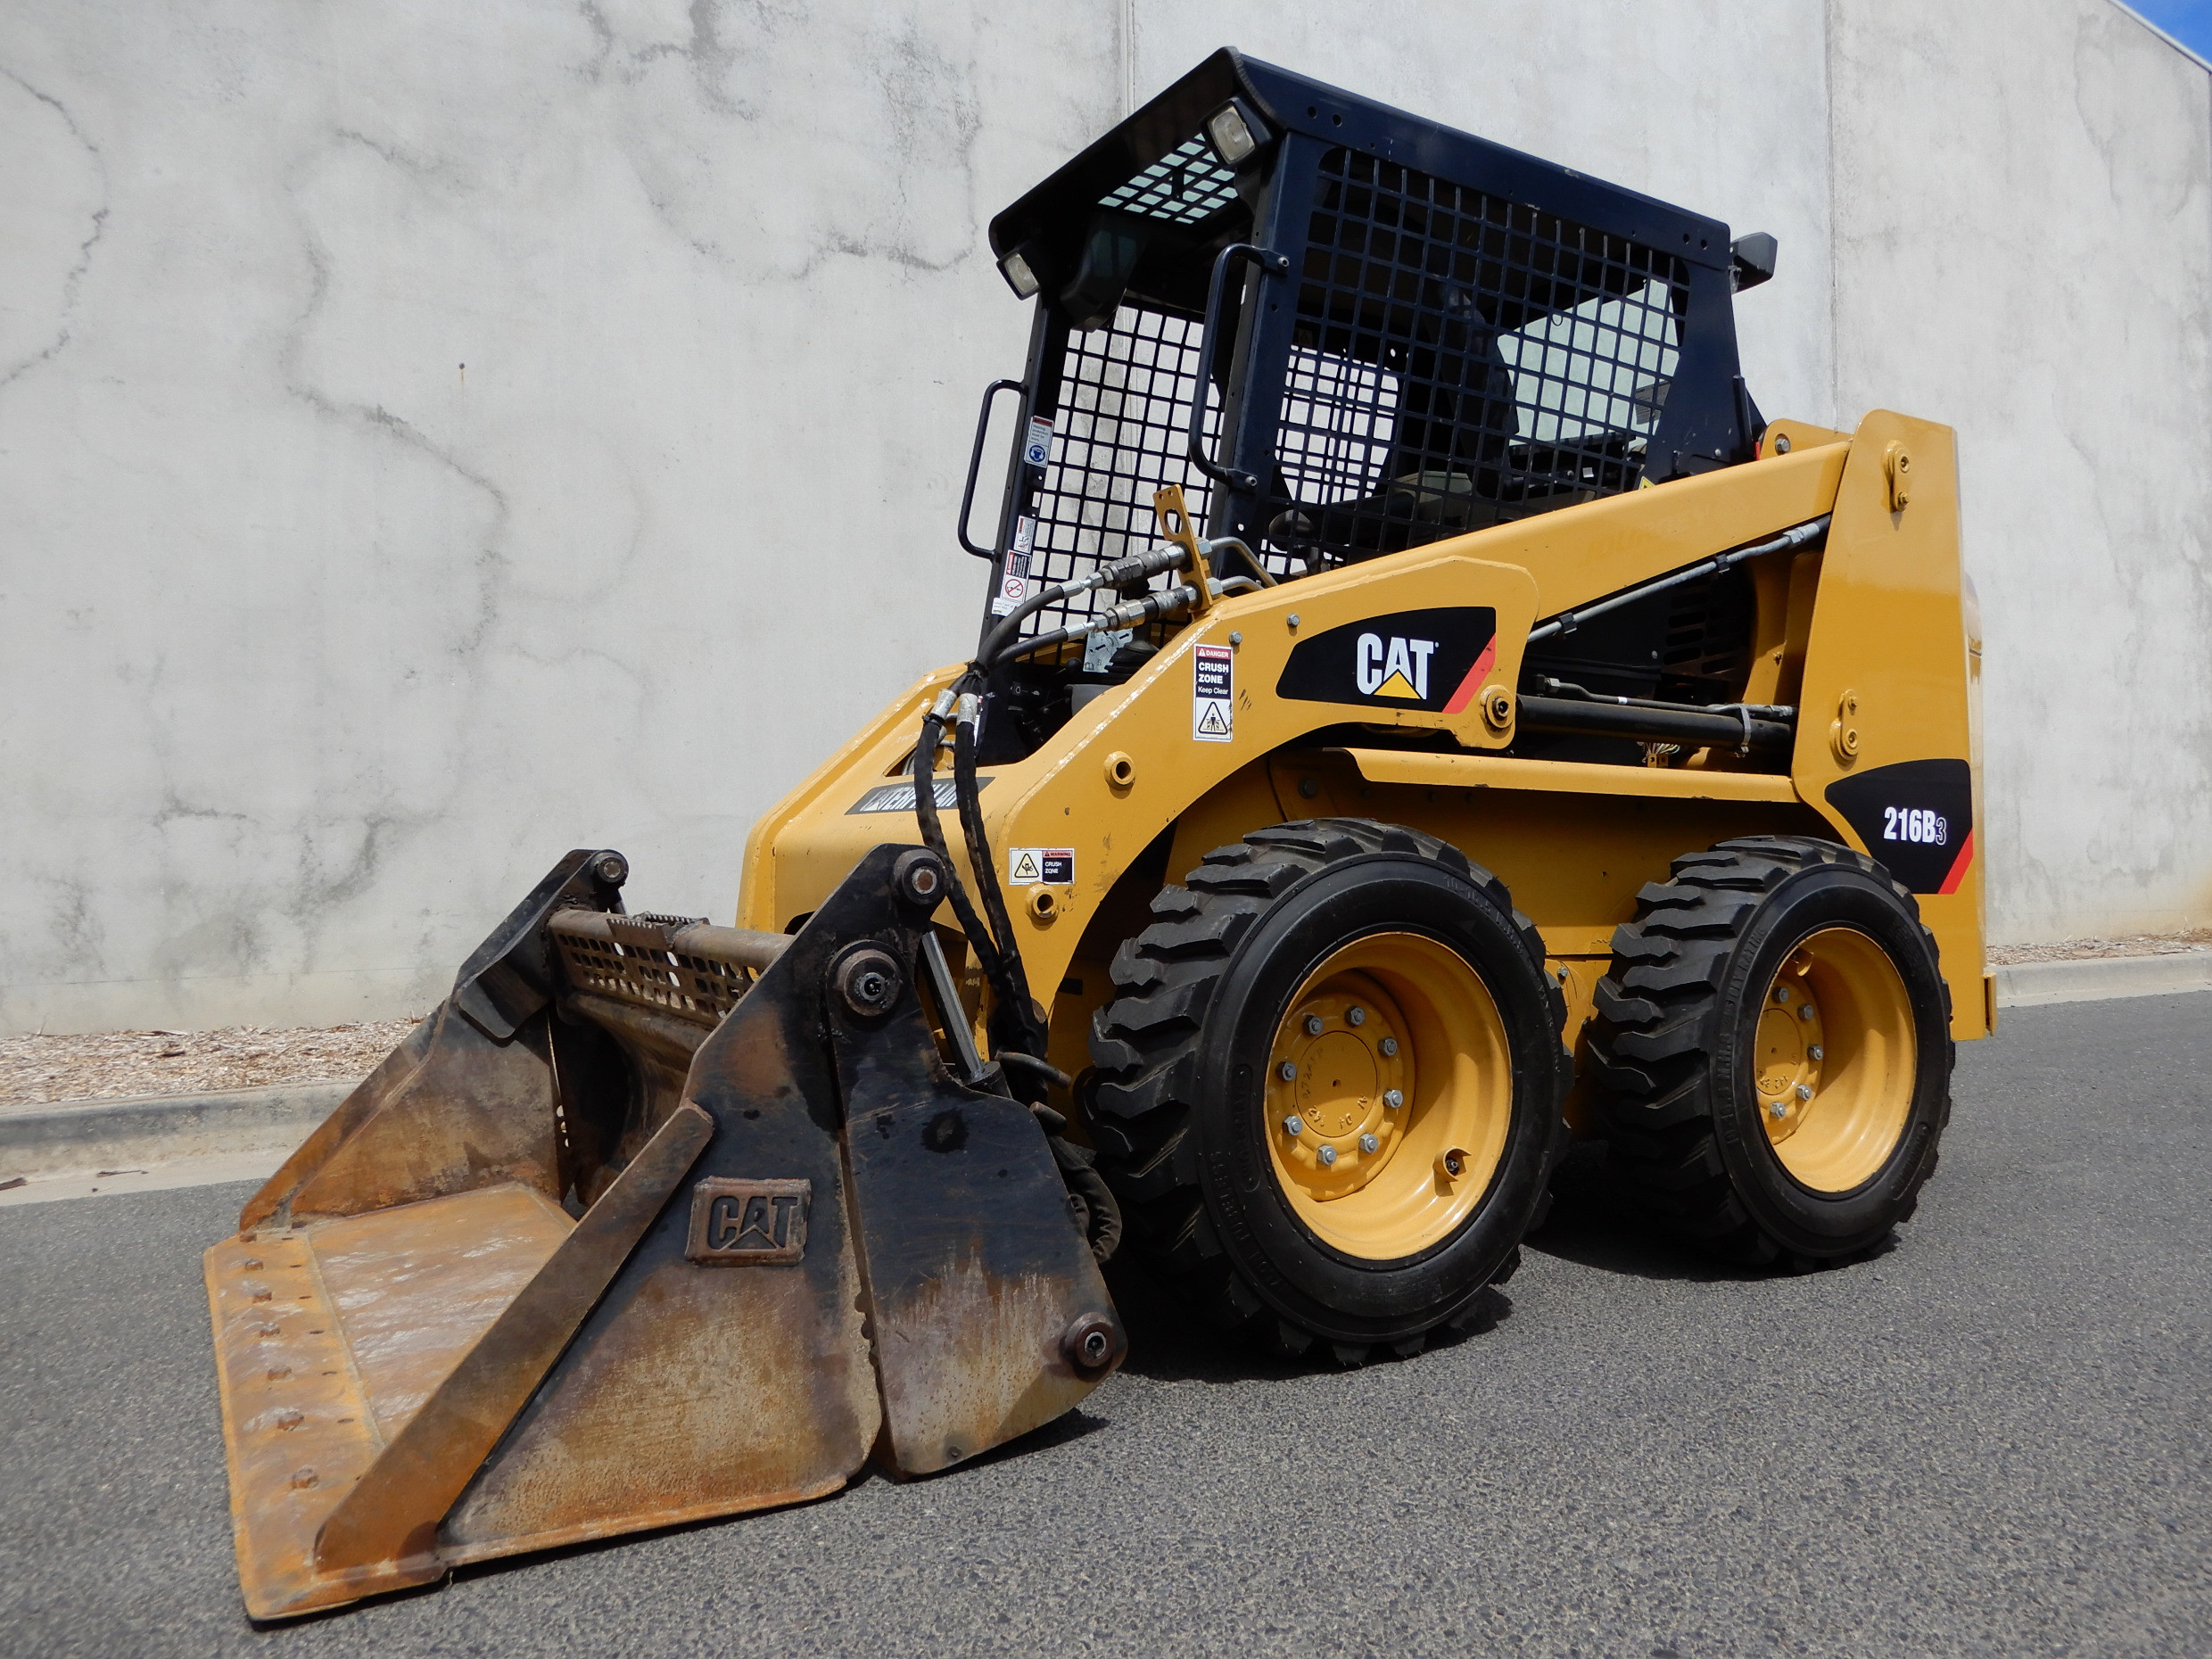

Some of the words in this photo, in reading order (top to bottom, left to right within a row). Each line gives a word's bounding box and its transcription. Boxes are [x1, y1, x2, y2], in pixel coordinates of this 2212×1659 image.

[1205, 649, 1229, 658] DANGER
[1198, 661, 1229, 673] CRUSH
[1356, 631, 1434, 700] CAT
[1198, 673, 1224, 684] ZONE
[1197, 686, 1213, 695] Keep
[1213, 687, 1229, 695] Clear
[706, 1194, 799, 1251] CAT
